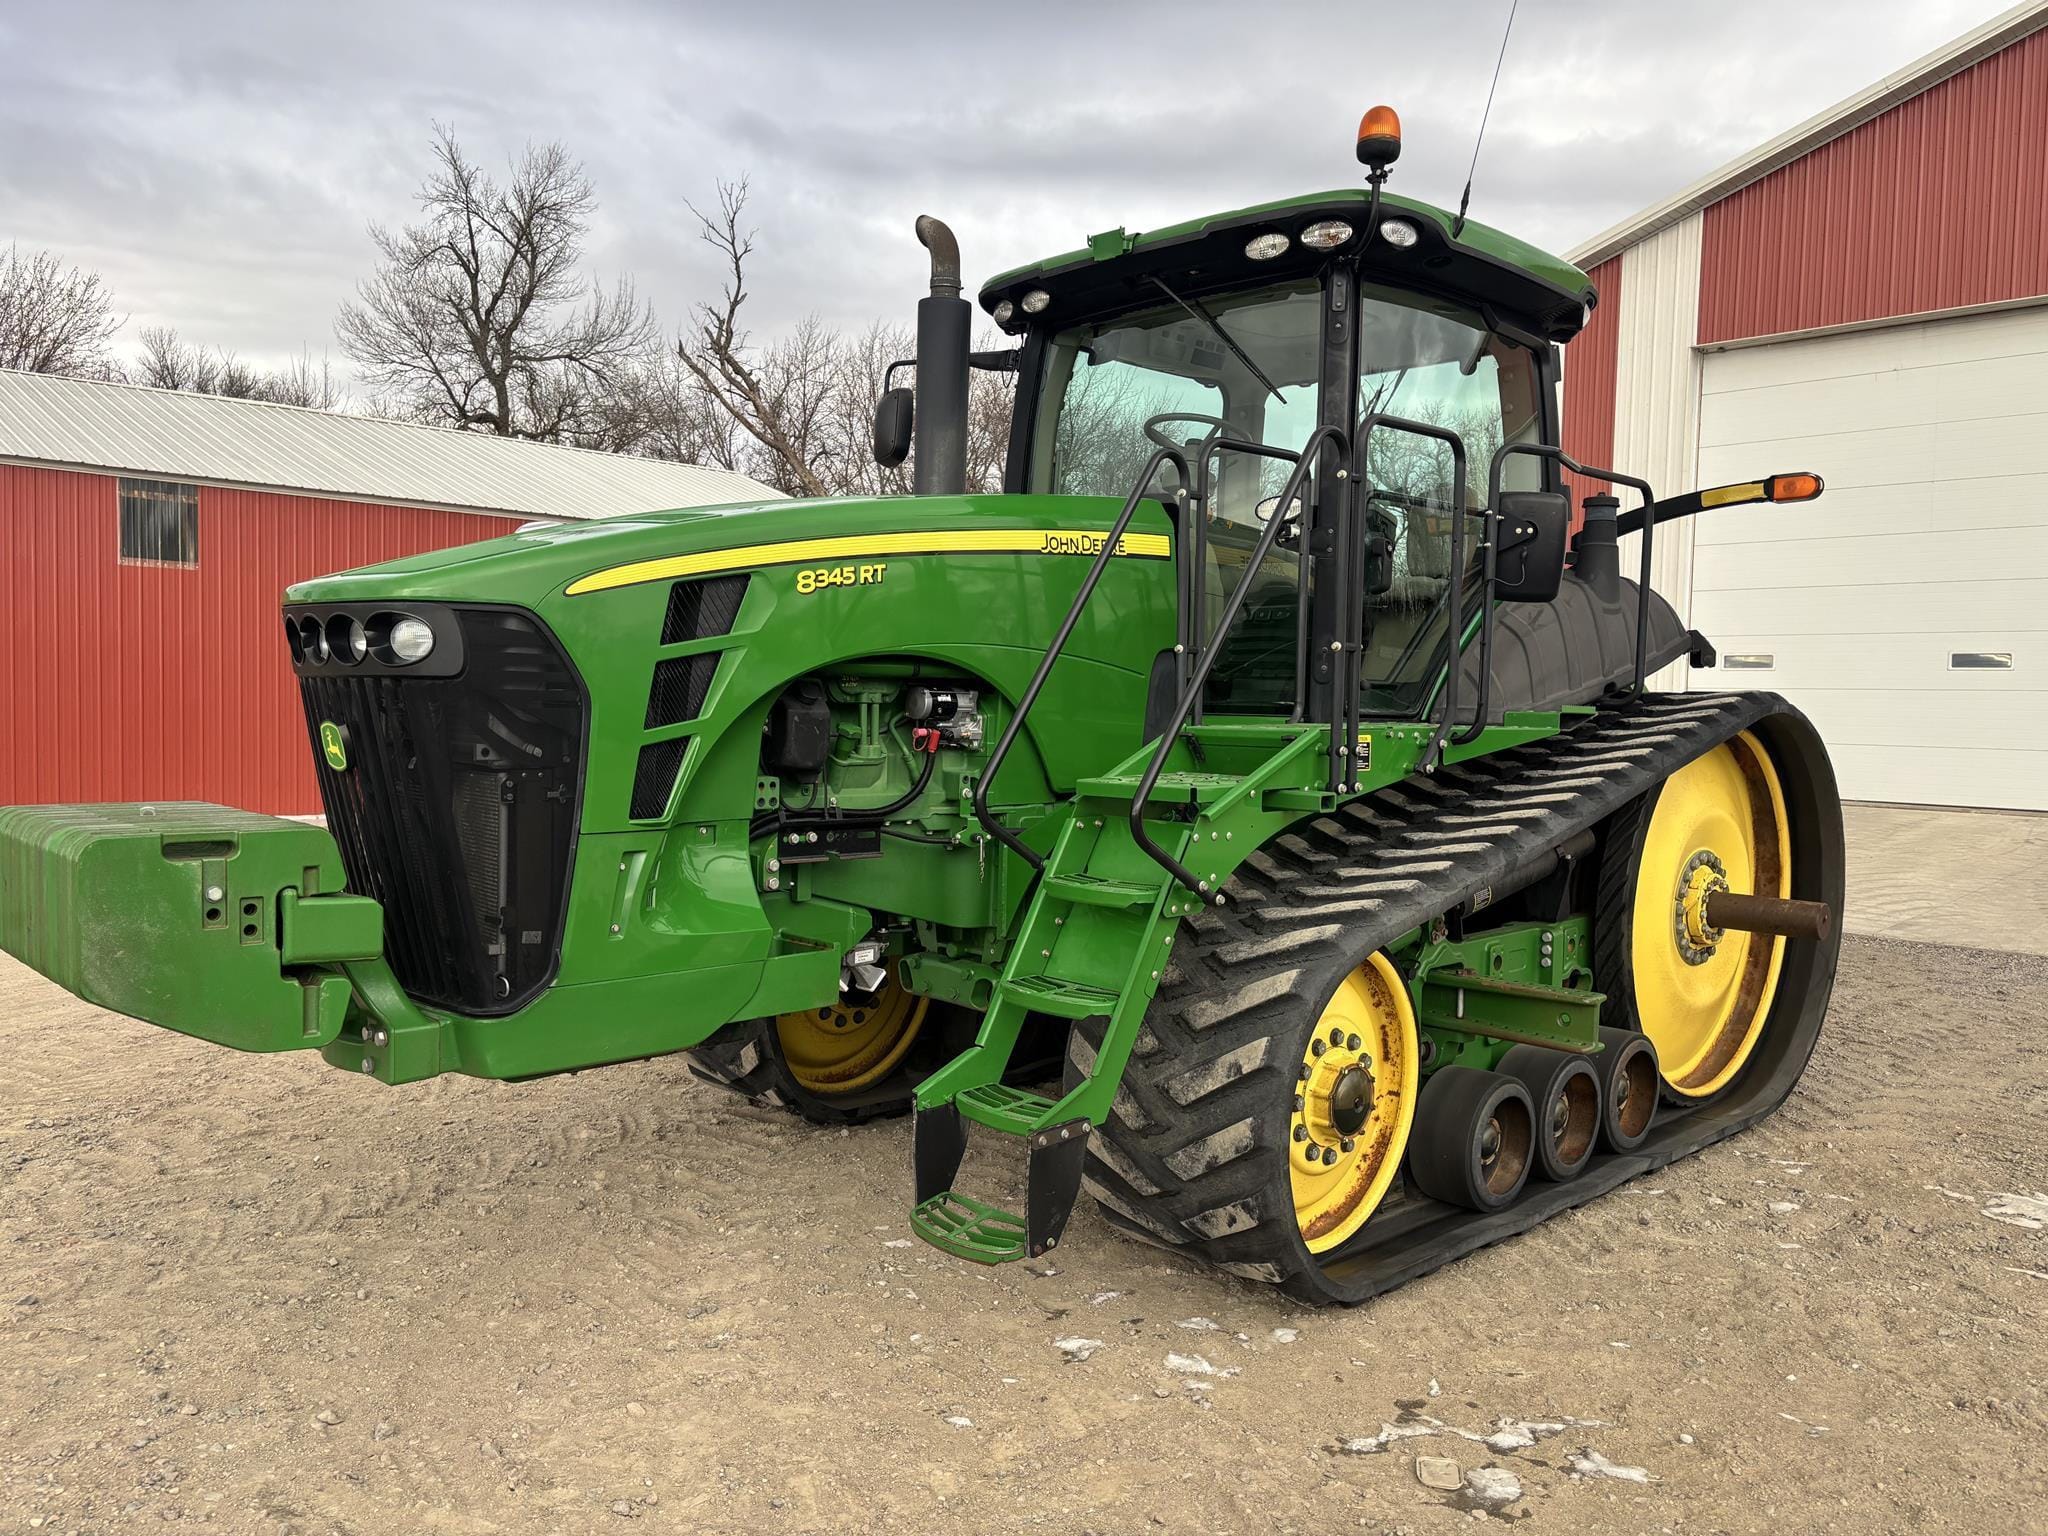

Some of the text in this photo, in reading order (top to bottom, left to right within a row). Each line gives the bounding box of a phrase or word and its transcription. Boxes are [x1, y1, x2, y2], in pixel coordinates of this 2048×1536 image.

[1041, 532, 1079, 553] JOHN
[796, 563, 887, 594] 8345 RT
